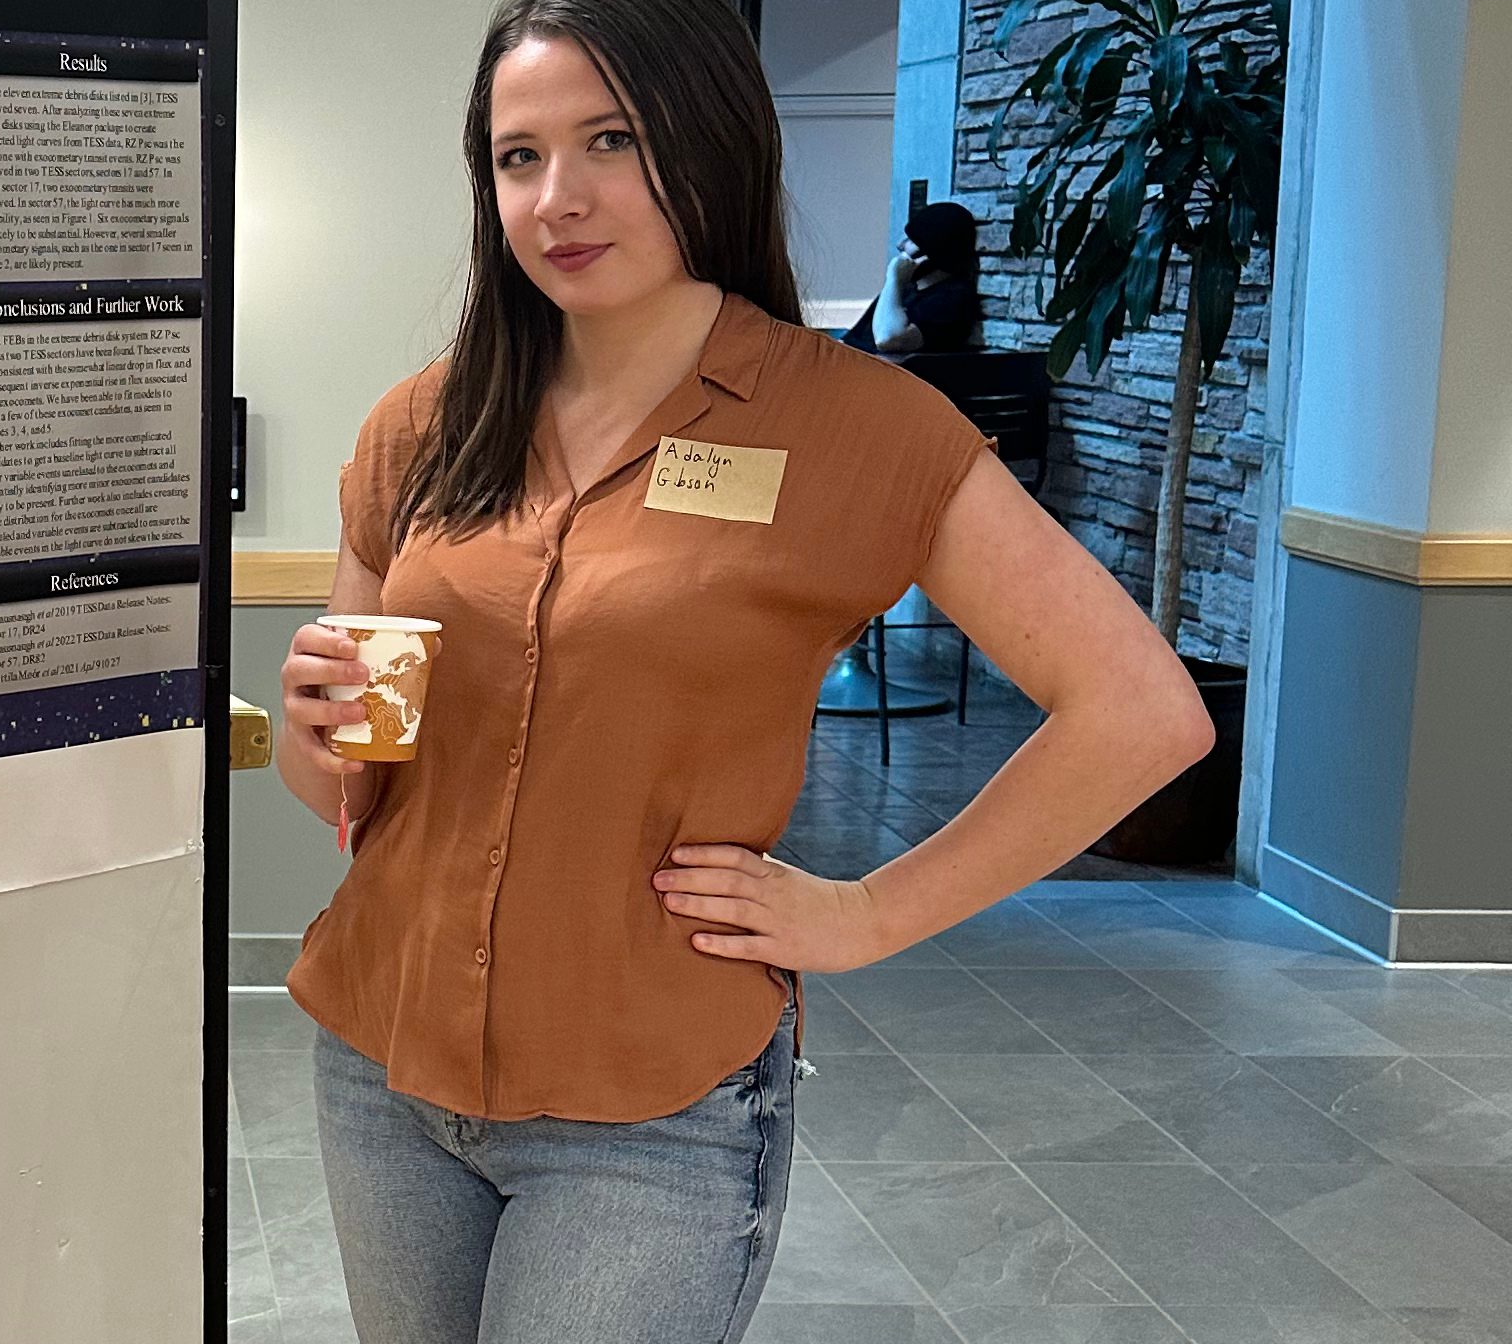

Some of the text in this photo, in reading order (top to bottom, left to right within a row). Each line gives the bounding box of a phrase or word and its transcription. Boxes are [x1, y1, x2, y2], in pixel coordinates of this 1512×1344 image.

[59, 52, 107, 72] Results
[68, 297, 91, 314] and
[96, 296, 140, 313] Further
[144, 294, 184, 311] Work
[664, 441, 732, 478] Adalyn
[50, 572, 118, 591] References
